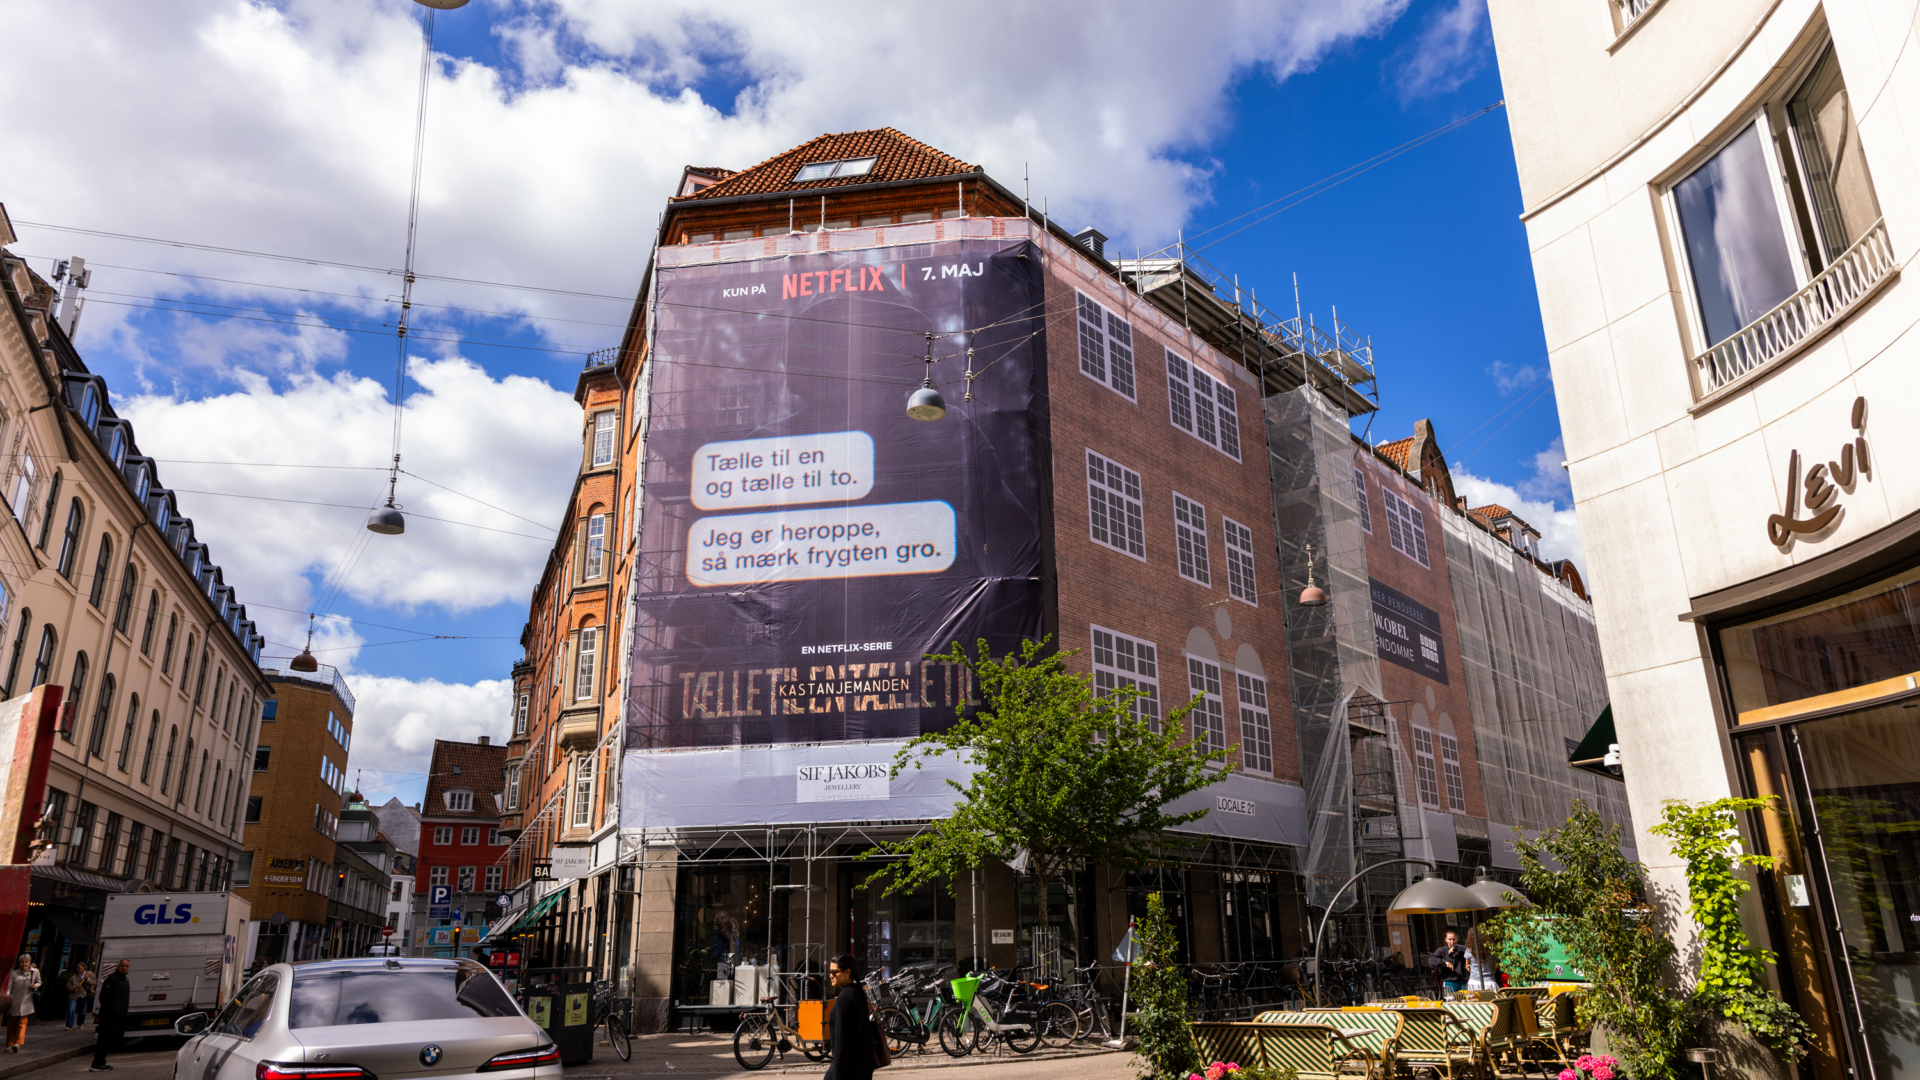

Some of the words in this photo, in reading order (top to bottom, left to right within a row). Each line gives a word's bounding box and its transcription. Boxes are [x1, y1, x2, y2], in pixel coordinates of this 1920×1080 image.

[723, 287, 748, 298] KUN
[751, 283, 766, 295] PÅ
[782, 266, 884, 300] NETFLIX
[921, 267, 936, 281] 7.
[941, 262, 984, 279] MAJ
[707, 453, 763, 471] Tælle
[771, 449, 790, 467] til
[799, 450, 825, 464] en
[706, 480, 732, 498] og
[741, 474, 794, 492] tælle
[803, 471, 821, 488] til
[830, 470, 858, 486] to.
[703, 529, 742, 549] Jeg
[751, 530, 773, 544] er
[781, 522, 880, 541] heroppe,
[702, 551, 727, 571] så
[736, 548, 799, 569] mærk
[808, 544, 887, 568] frygten
[897, 542, 941, 563] gro.
[801, 646, 815, 655] EN
[817, 641, 892, 654] NETFLIX-SERIE
[779, 678, 910, 697] KASTANJEMANDEN
[799, 766, 824, 781] SIF
[824, 764, 887, 783] JAKOBS
[824, 783, 862, 791] JEWELLERY
[1217, 797, 1246, 813] LOCALE
[1247, 802, 1255, 814] 21
[534, 866, 552, 877] BA
[435, 887, 447, 904] P
